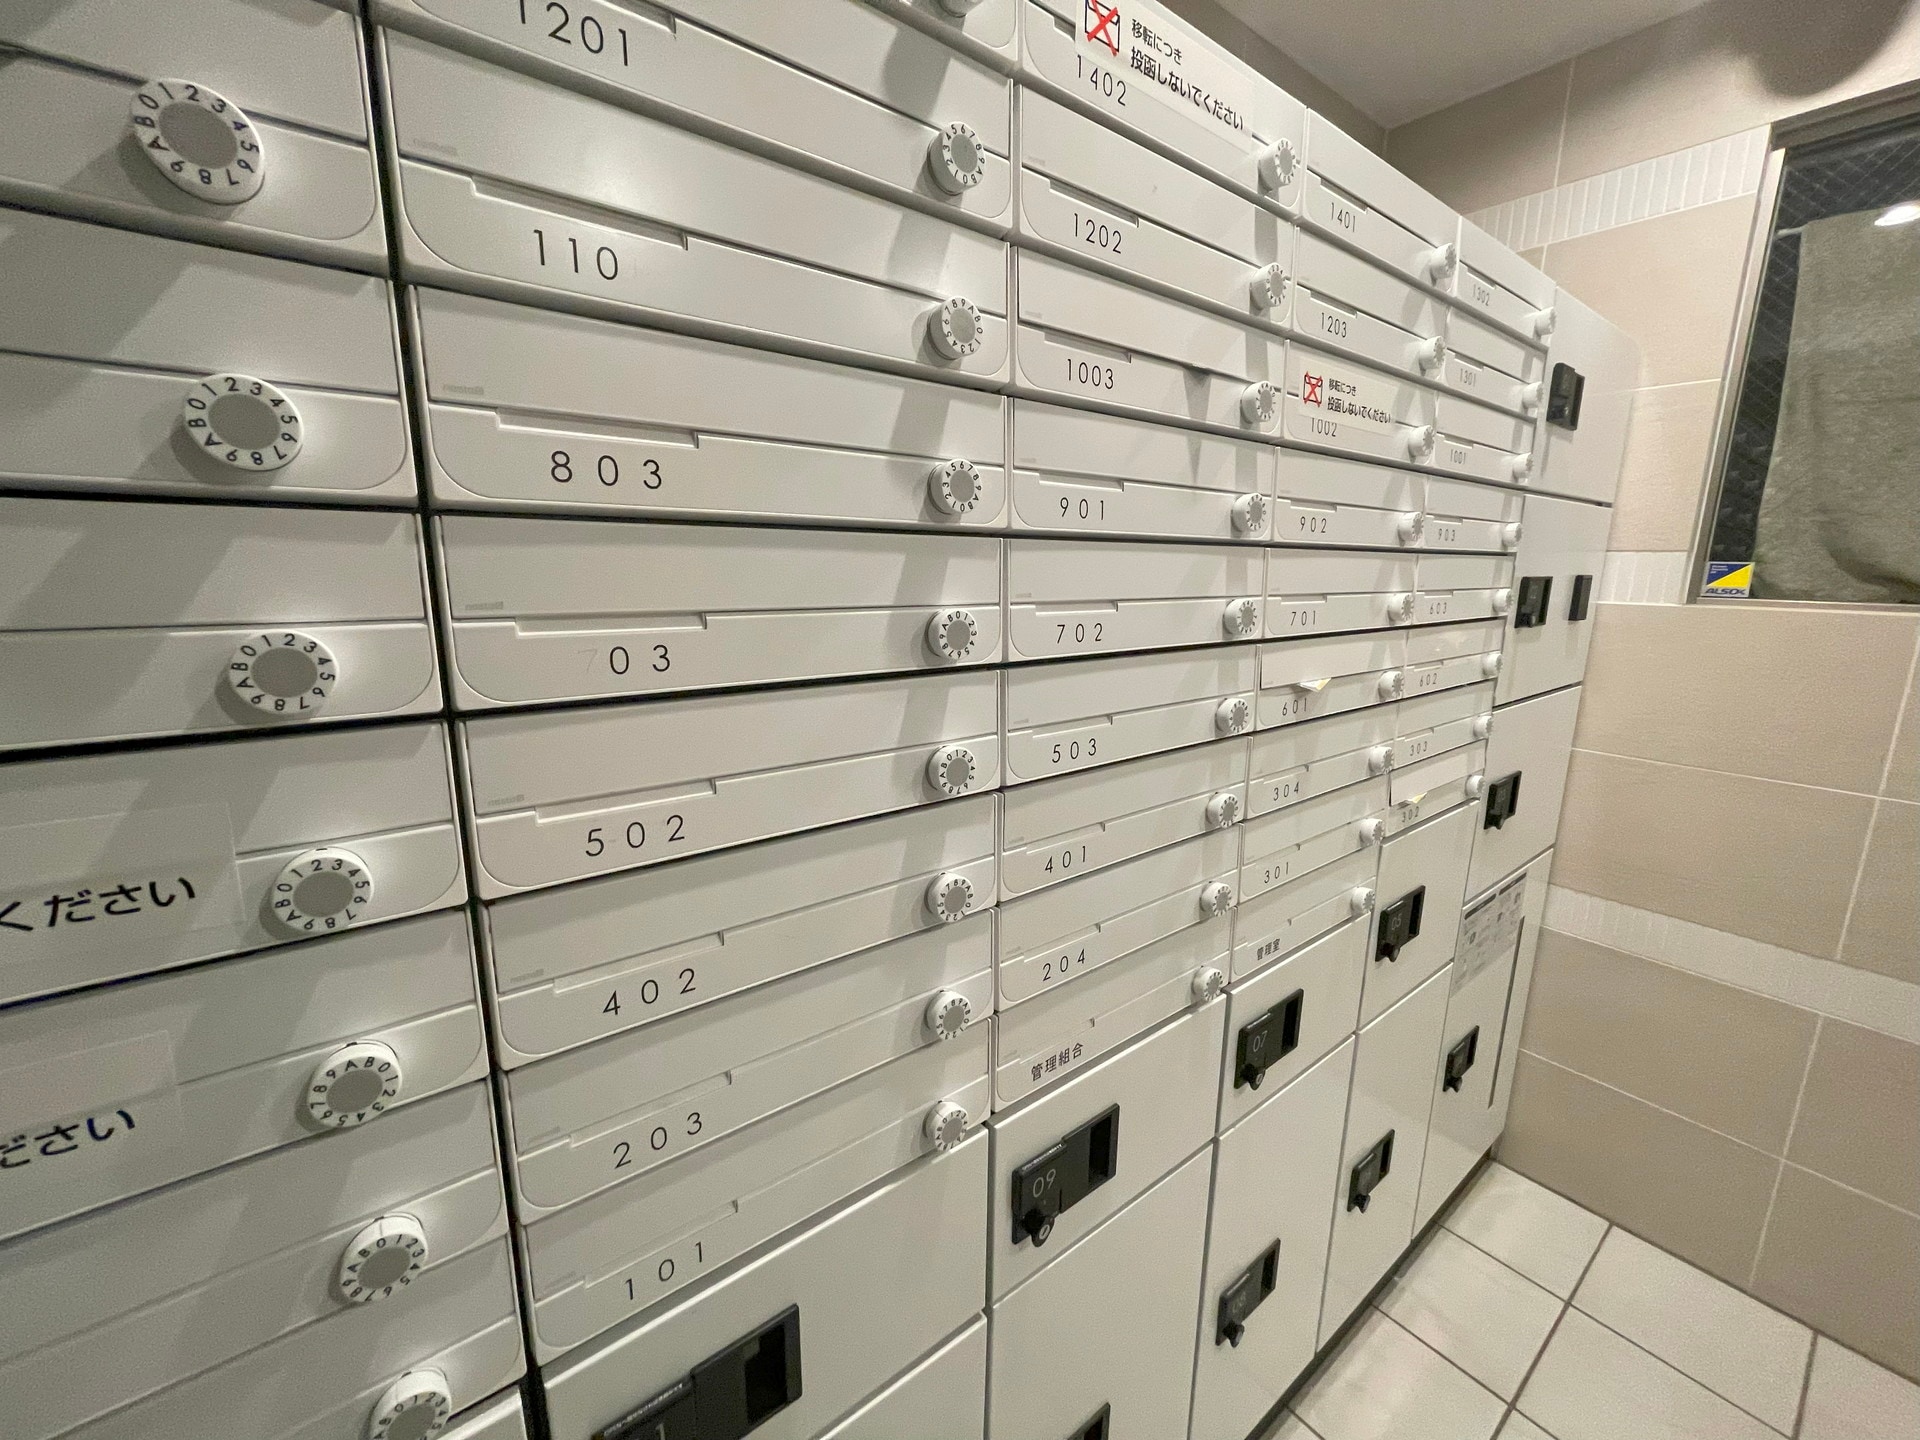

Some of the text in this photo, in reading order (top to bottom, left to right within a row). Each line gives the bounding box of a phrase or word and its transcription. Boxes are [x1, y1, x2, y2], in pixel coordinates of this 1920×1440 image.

[519, 0, 629, 67] 1201
[1131, 19, 1182, 66] 移転につき
[1077, 55, 1127, 107] 1402
[1130, 46, 1245, 131] 投函しないでください
[1330, 202, 1357, 233] 1401
[1074, 213, 1122, 254] 1202
[534, 229, 618, 280] 110
[1321, 312, 1347, 338] 1203
[1067, 358, 1114, 390] 1003
[551, 450, 662, 489] 803
[1060, 497, 1104, 521] 901
[1300, 516, 1328, 534] 902
[1438, 529, 1456, 542] 903
[1291, 610, 1317, 626] 701
[1429, 602, 1448, 615] 603
[1056, 623, 1103, 644] 702
[1419, 673, 1438, 687] 602
[1282, 698, 1307, 717] 601
[1051, 738, 1097, 764] 503
[1410, 741, 1428, 757] 303
[1273, 781, 1300, 801] 304
[585, 815, 685, 857] 502
[1045, 846, 1086, 874] 401
[1264, 862, 1289, 884] 301
[1043, 948, 1086, 982] 204
[602, 968, 696, 1016] 402
[1031, 1042, 1084, 1082] 管理組合
[613, 1112, 703, 1169] 203
[1033, 1169, 1056, 1198] 09
[625, 1241, 703, 1300] 101
